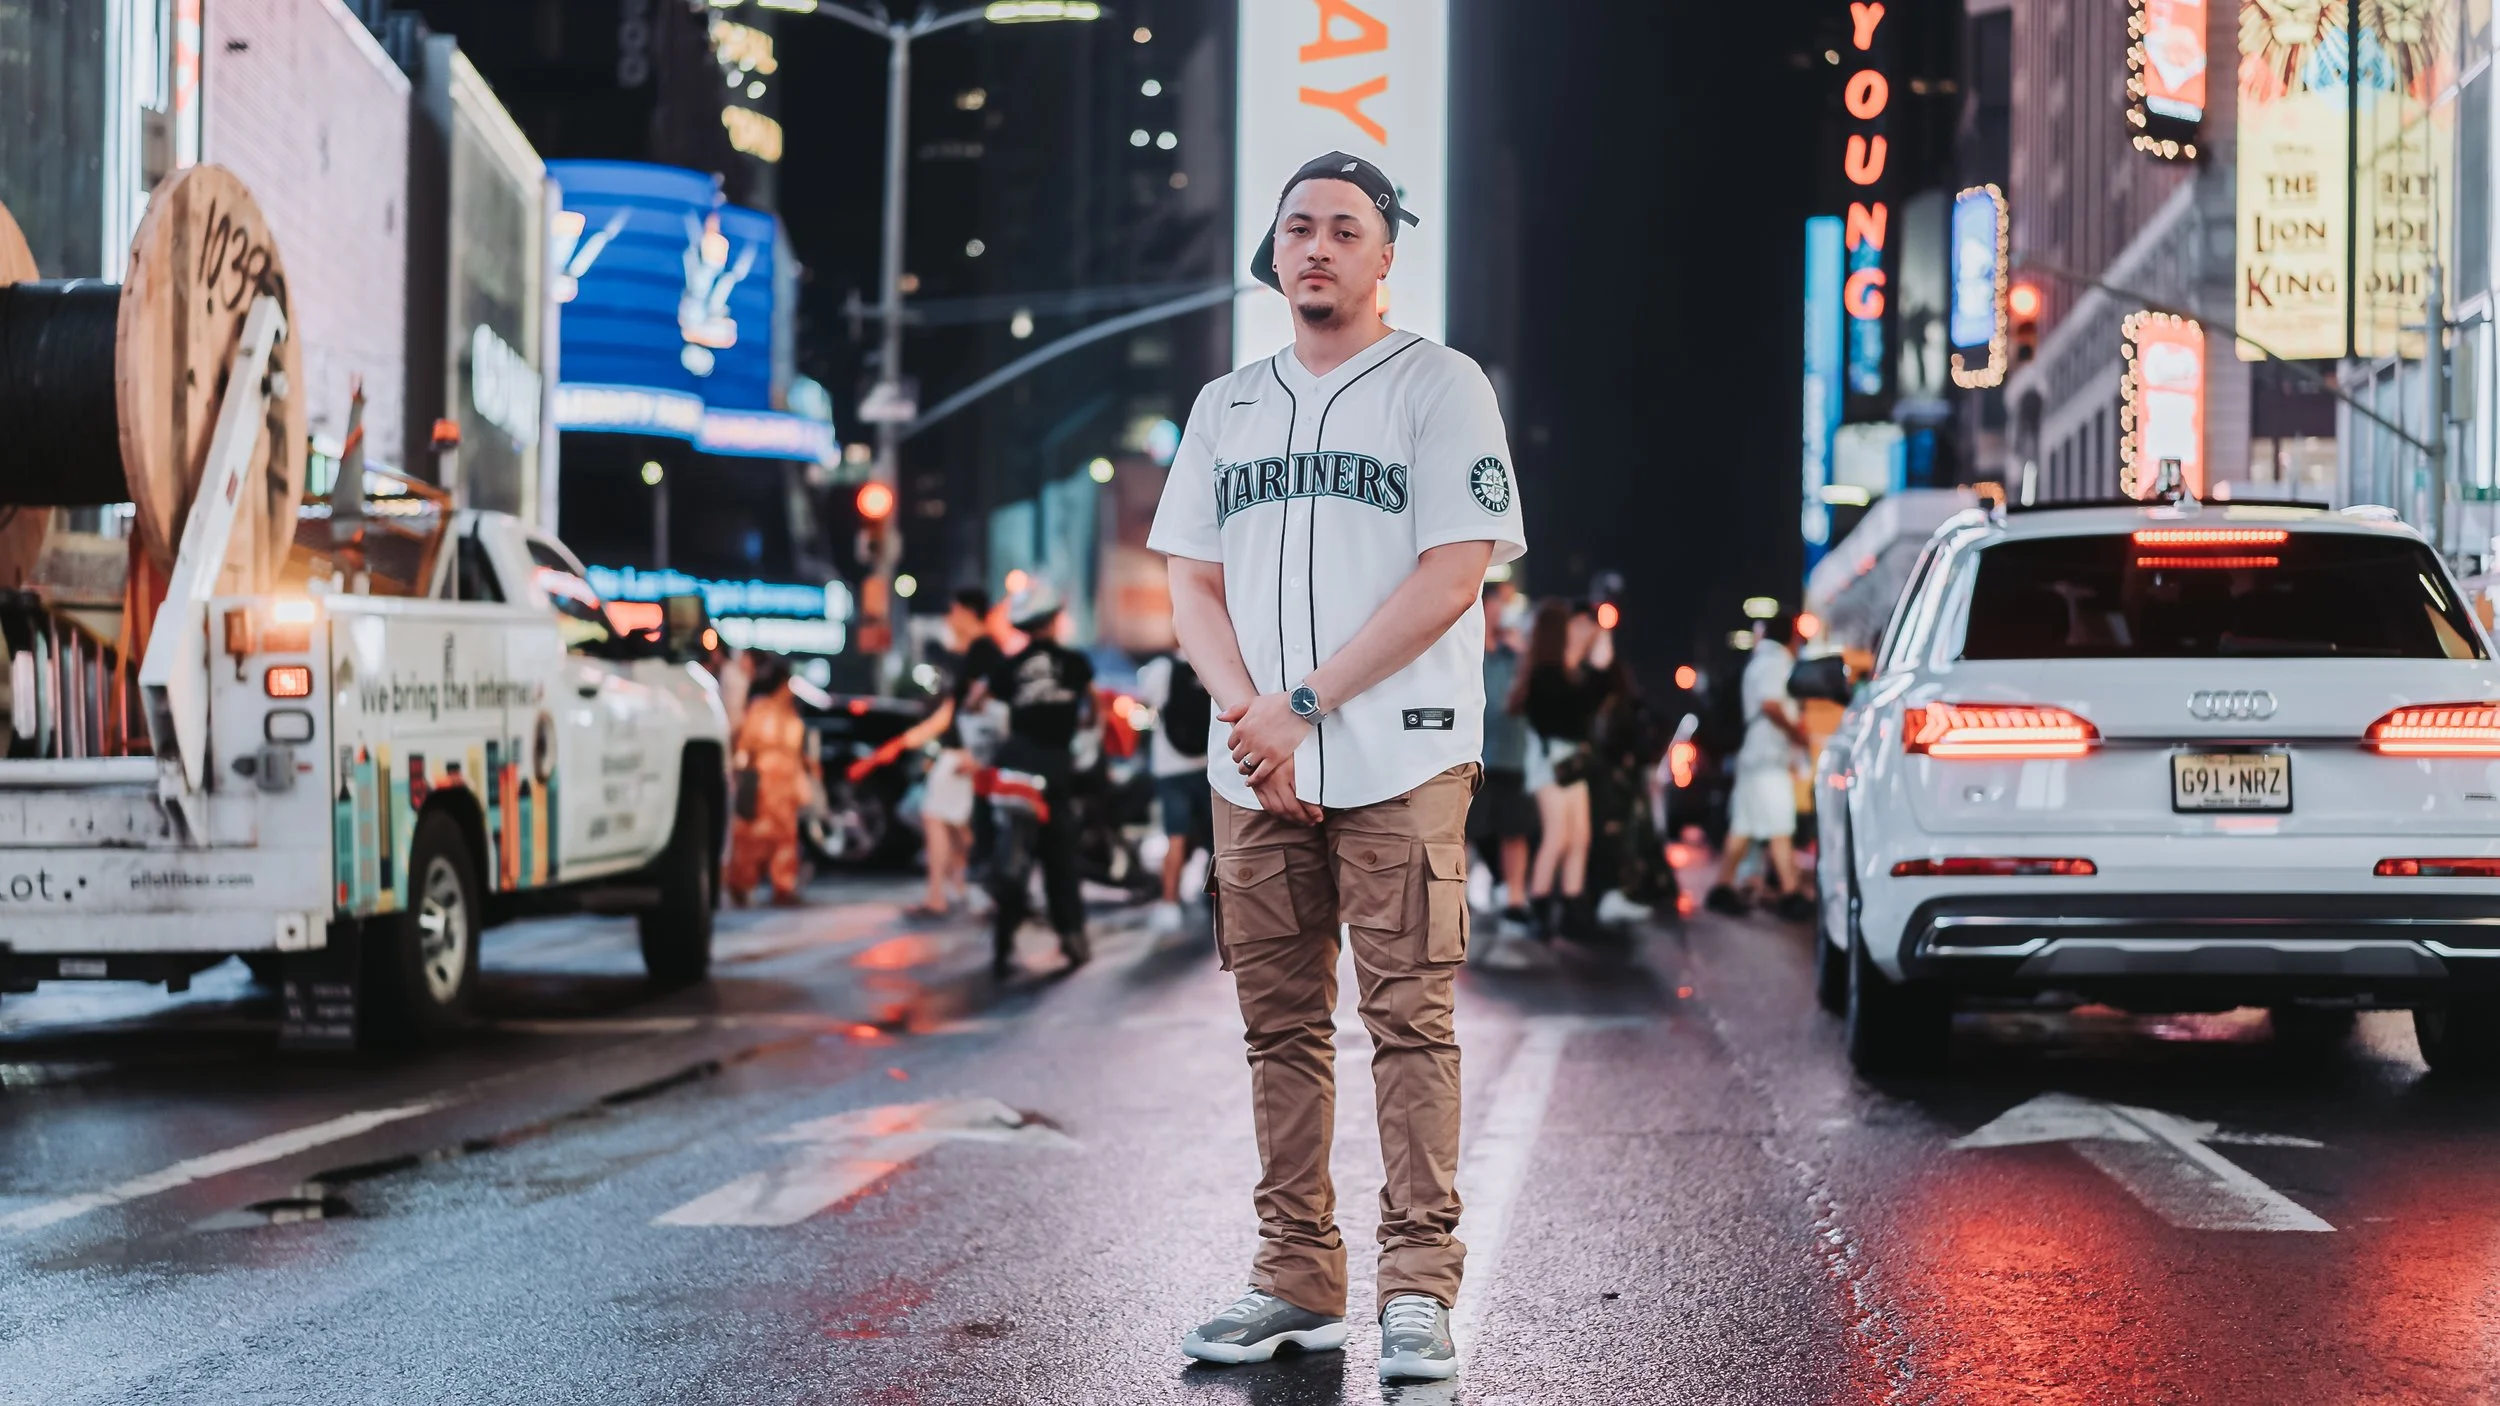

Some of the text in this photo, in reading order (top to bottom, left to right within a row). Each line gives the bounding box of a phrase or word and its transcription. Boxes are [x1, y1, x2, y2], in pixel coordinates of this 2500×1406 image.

[1844, 2, 1889, 320] YOUNG
[2266, 174, 2316, 195] THE
[2256, 216, 2326, 252] LION
[2247, 265, 2336, 308] KING
[1214, 451, 1409, 530] MARINERS
[1473, 487, 1509, 511] MARINERS
[360, 679, 388, 714] We
[392, 671, 437, 722] bring
[444, 674, 467, 711] the
[2182, 767, 2281, 795] G91 NRZ
